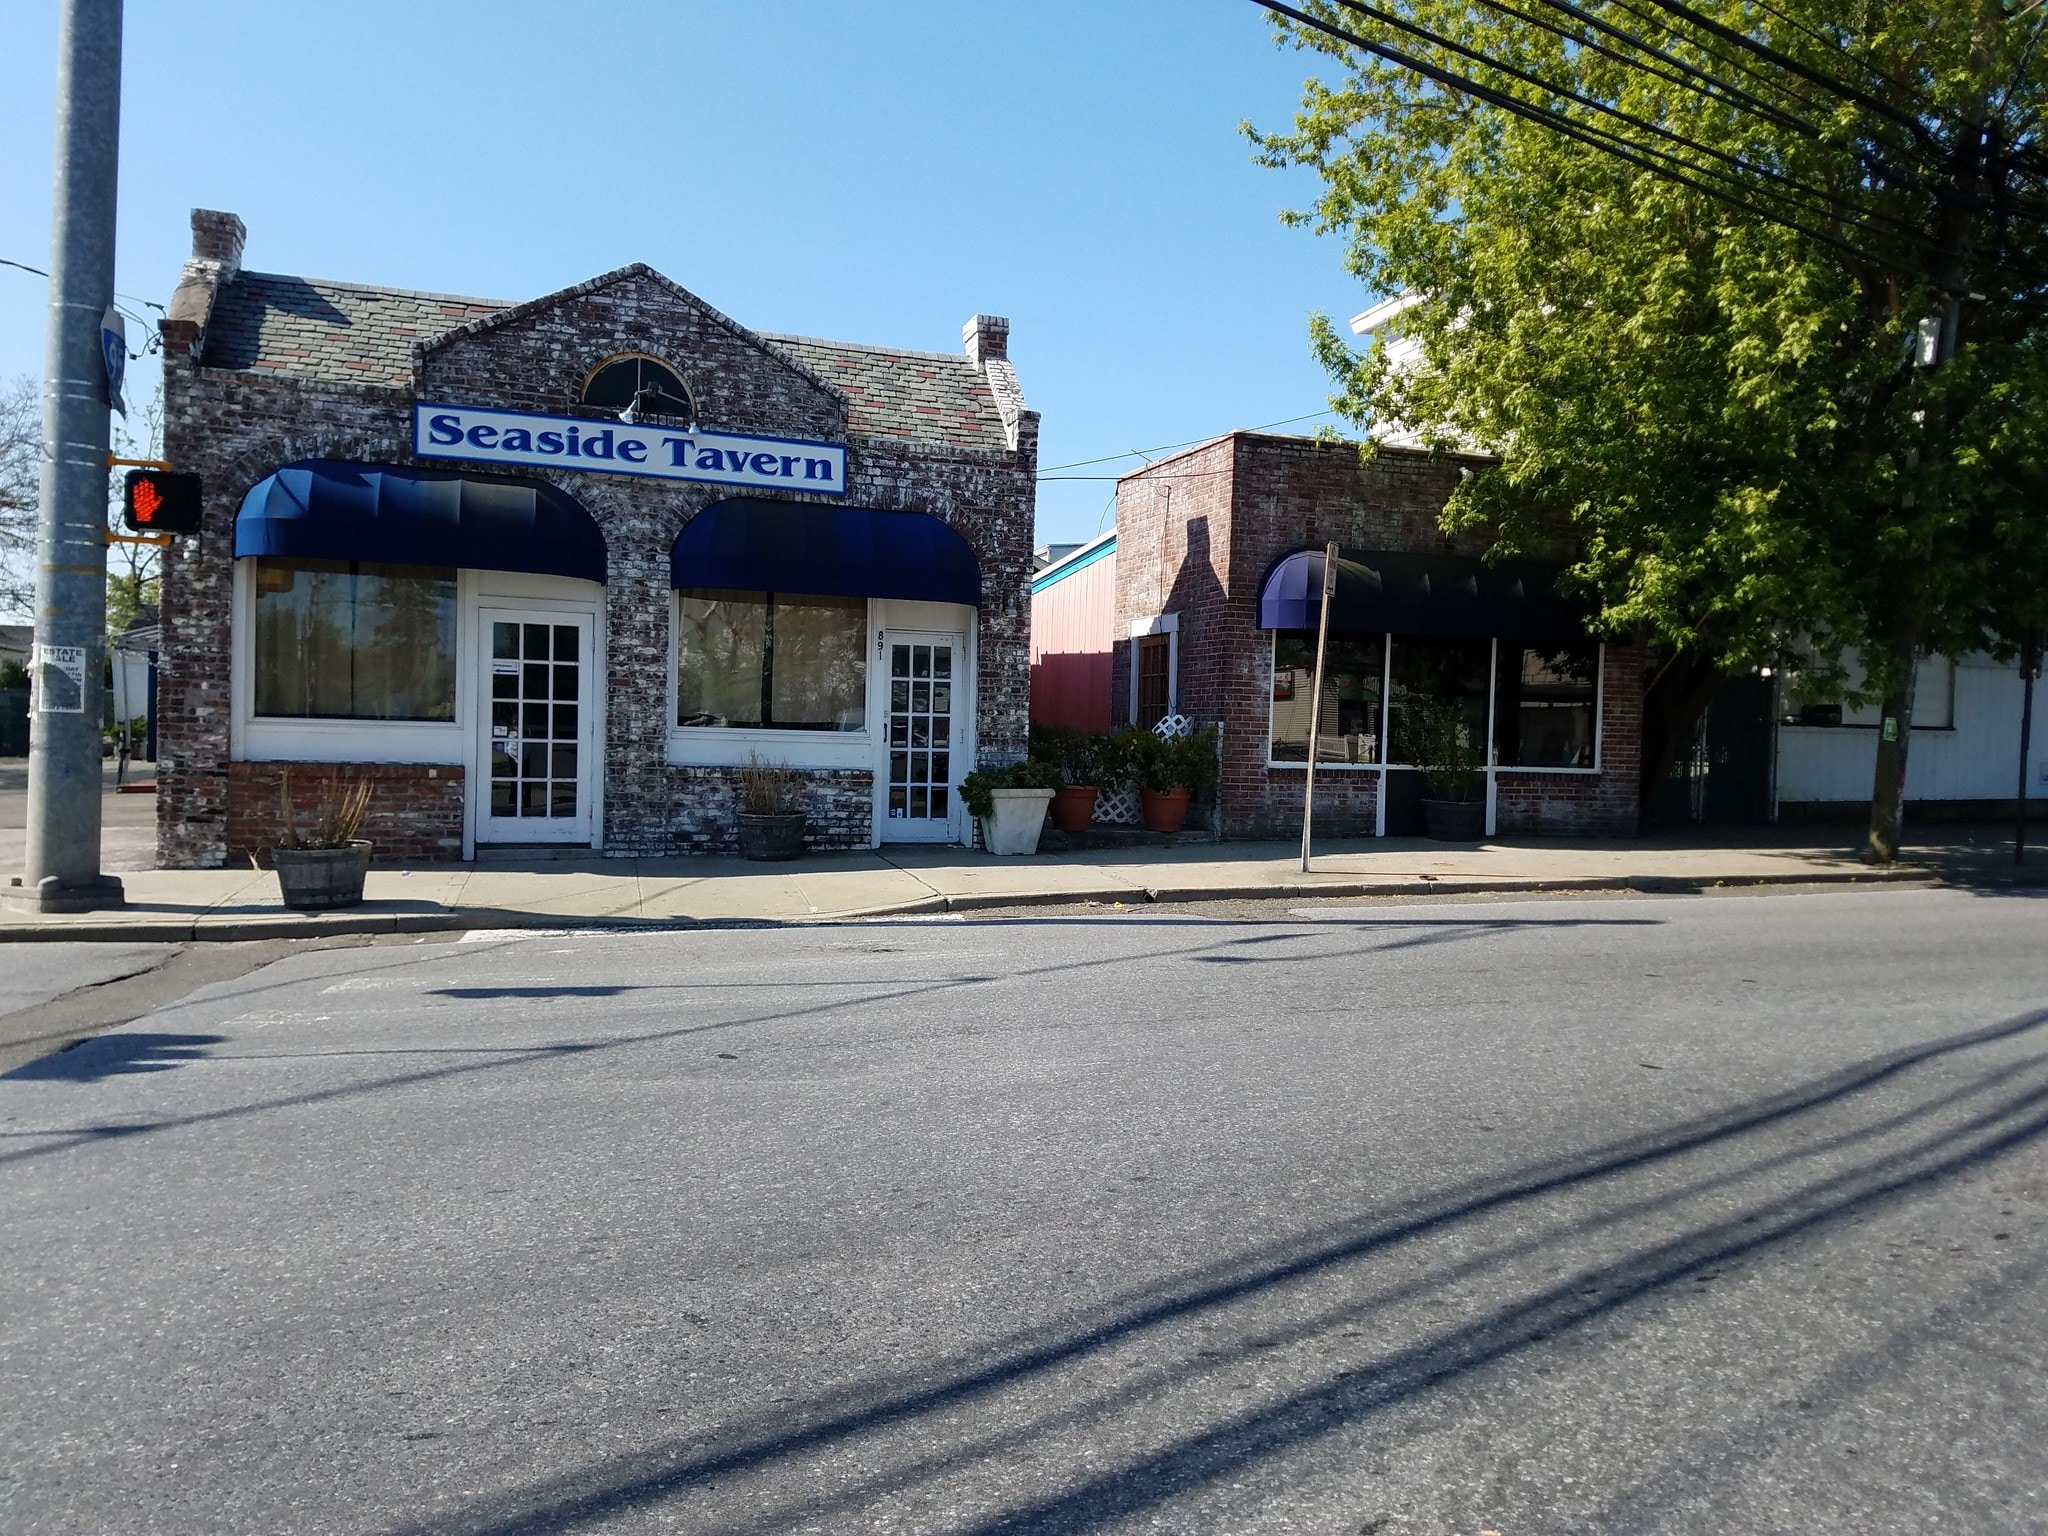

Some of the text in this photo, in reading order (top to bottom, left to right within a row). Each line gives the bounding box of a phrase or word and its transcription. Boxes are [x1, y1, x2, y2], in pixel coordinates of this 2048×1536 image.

[429, 414, 834, 481] Seaside Tavern
[43, 648, 82, 656] ESTATE
